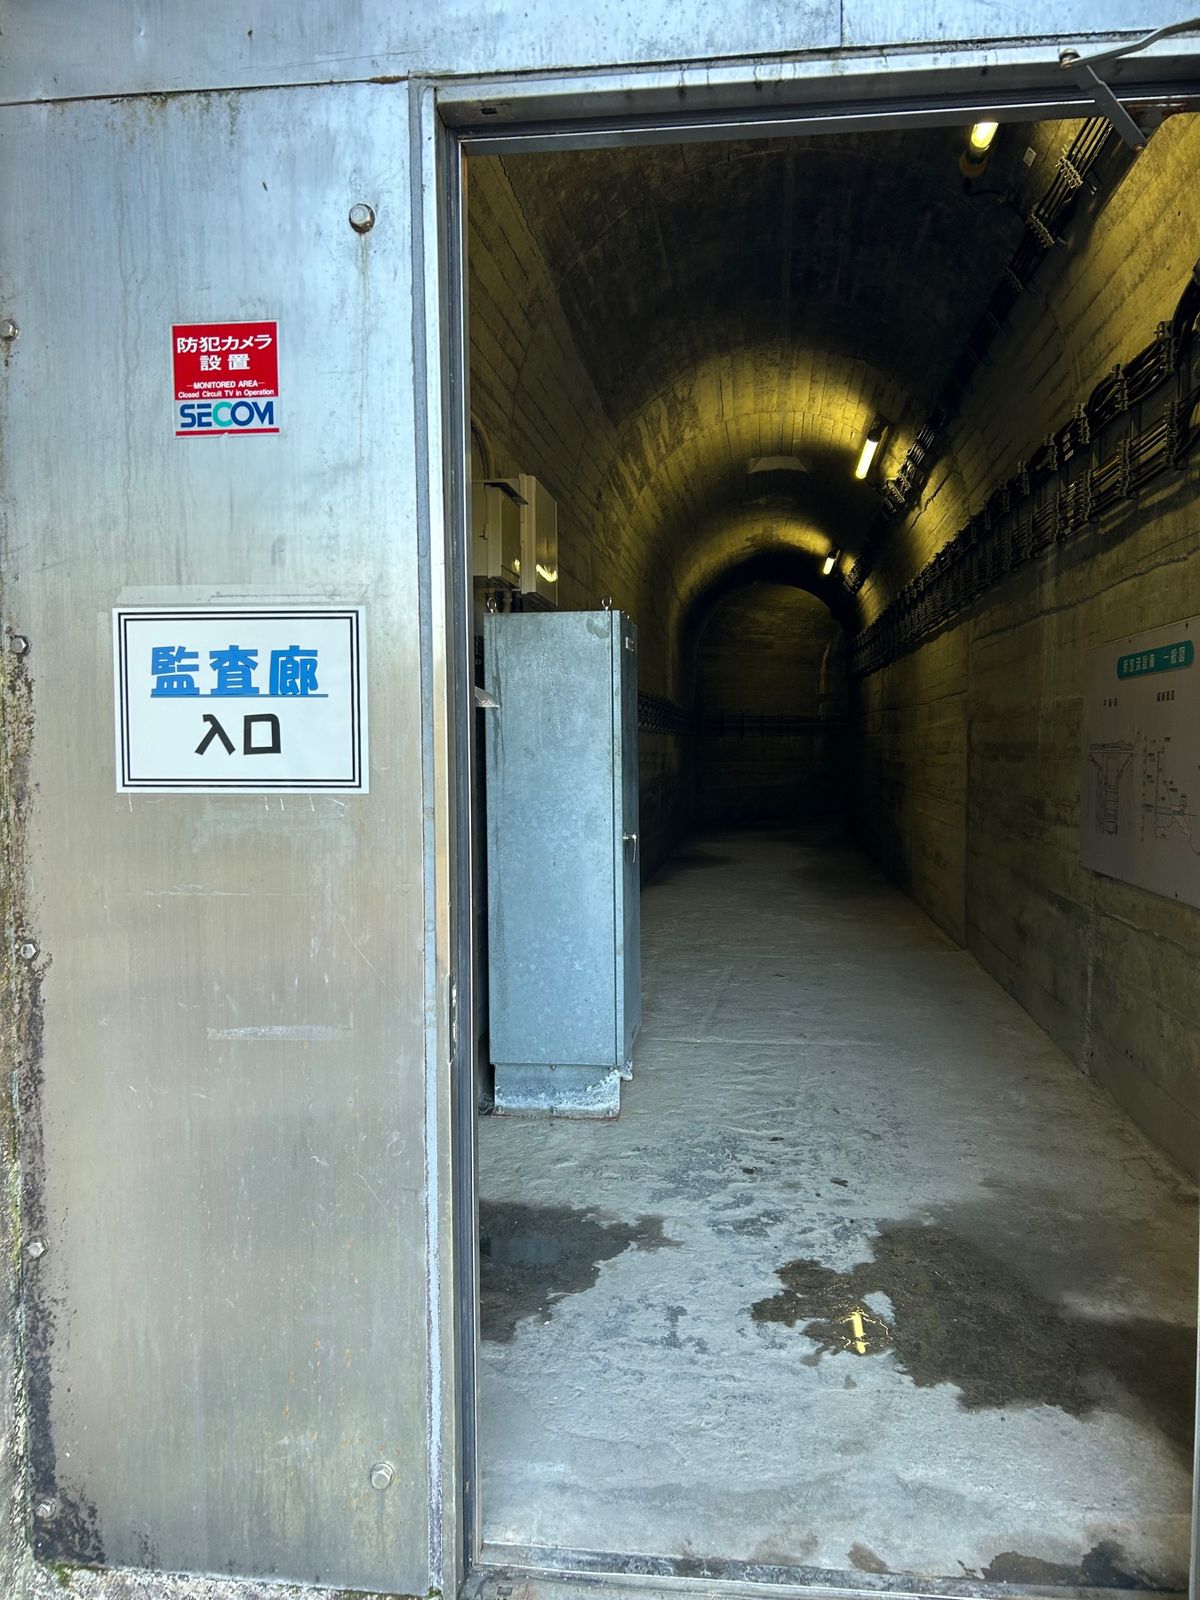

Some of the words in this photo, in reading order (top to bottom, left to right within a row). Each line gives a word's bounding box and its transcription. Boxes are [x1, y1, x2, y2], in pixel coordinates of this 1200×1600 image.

[177, 334, 272, 353] 防犯カメラ
[200, 353, 250, 371] 設置
[193, 380, 236, 389] MONITORED
[202, 390, 222, 398] Circuit
[244, 388, 274, 397] Operation
[180, 401, 274, 428] SECOM
[150, 645, 319, 696] 監査廊
[194, 713, 282, 756] 入口
